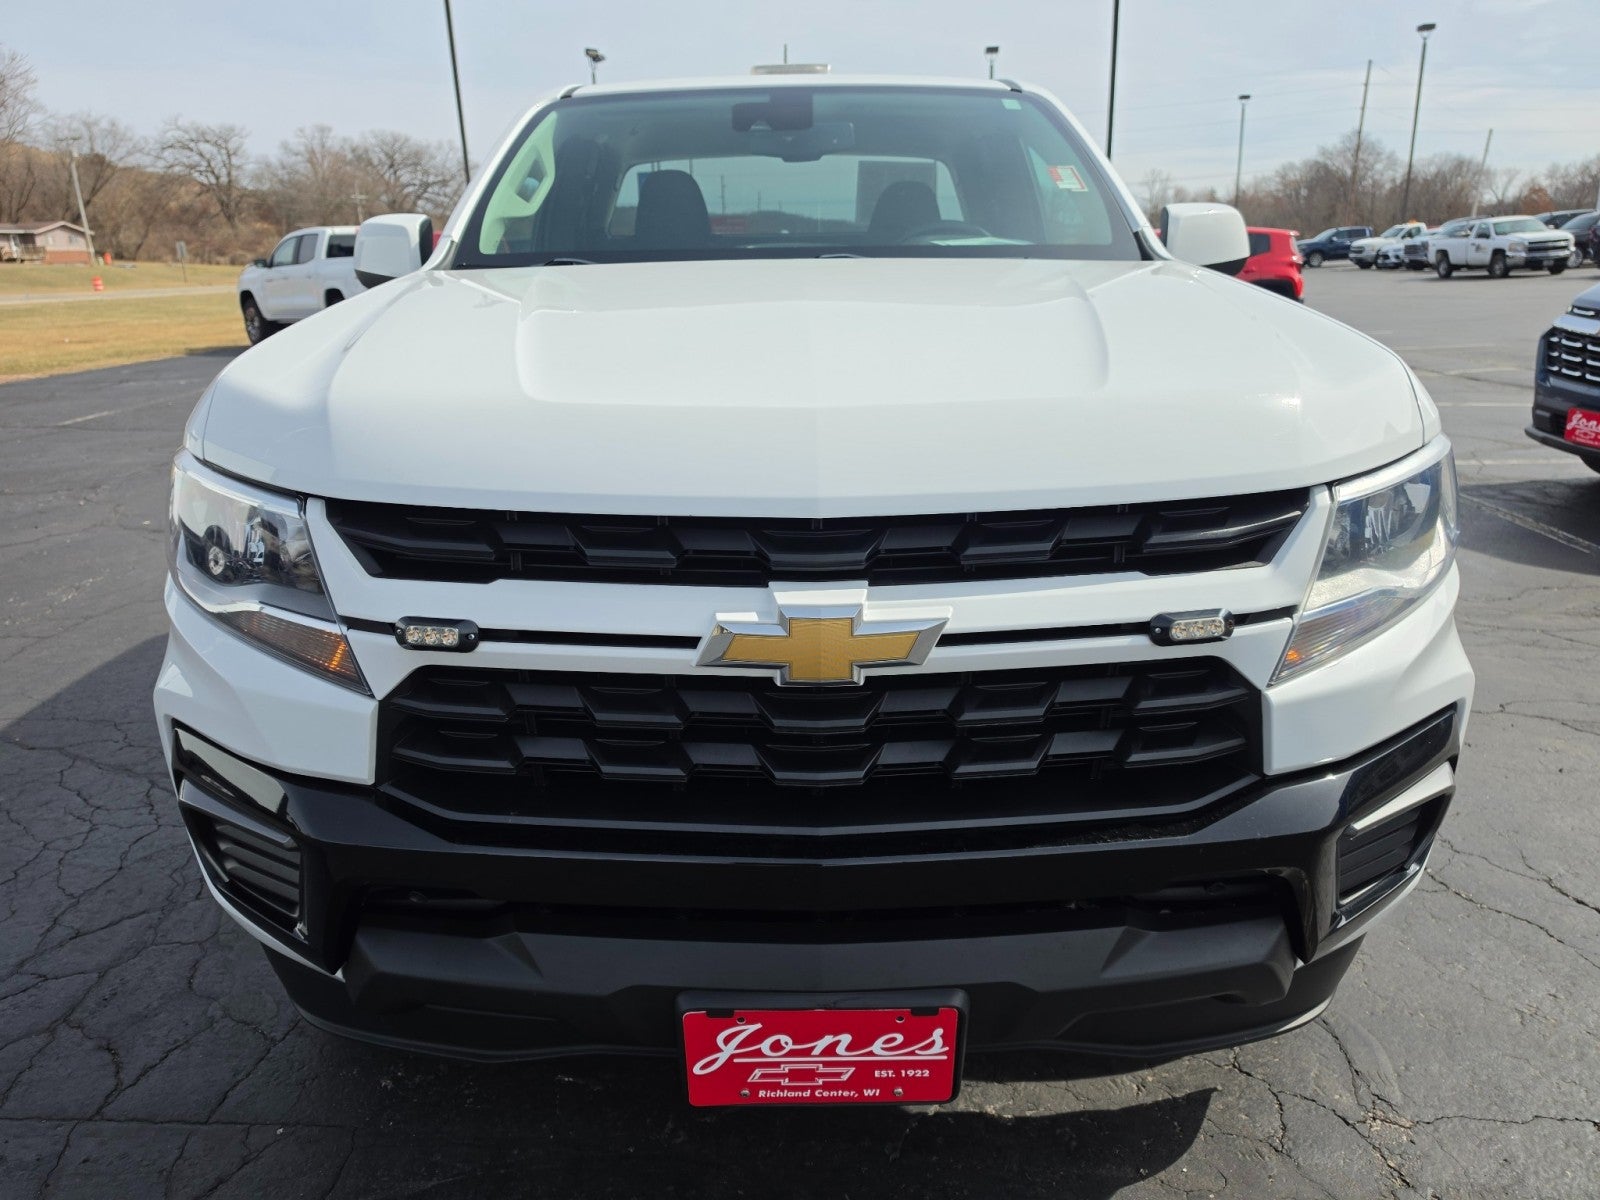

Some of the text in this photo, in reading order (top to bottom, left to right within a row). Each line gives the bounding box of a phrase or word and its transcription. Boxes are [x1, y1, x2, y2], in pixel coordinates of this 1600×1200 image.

[693, 1023, 949, 1075] Jones
[874, 1069, 930, 1078] EST. 1922
[758, 1088, 880, 1098] Richland Center, WI
